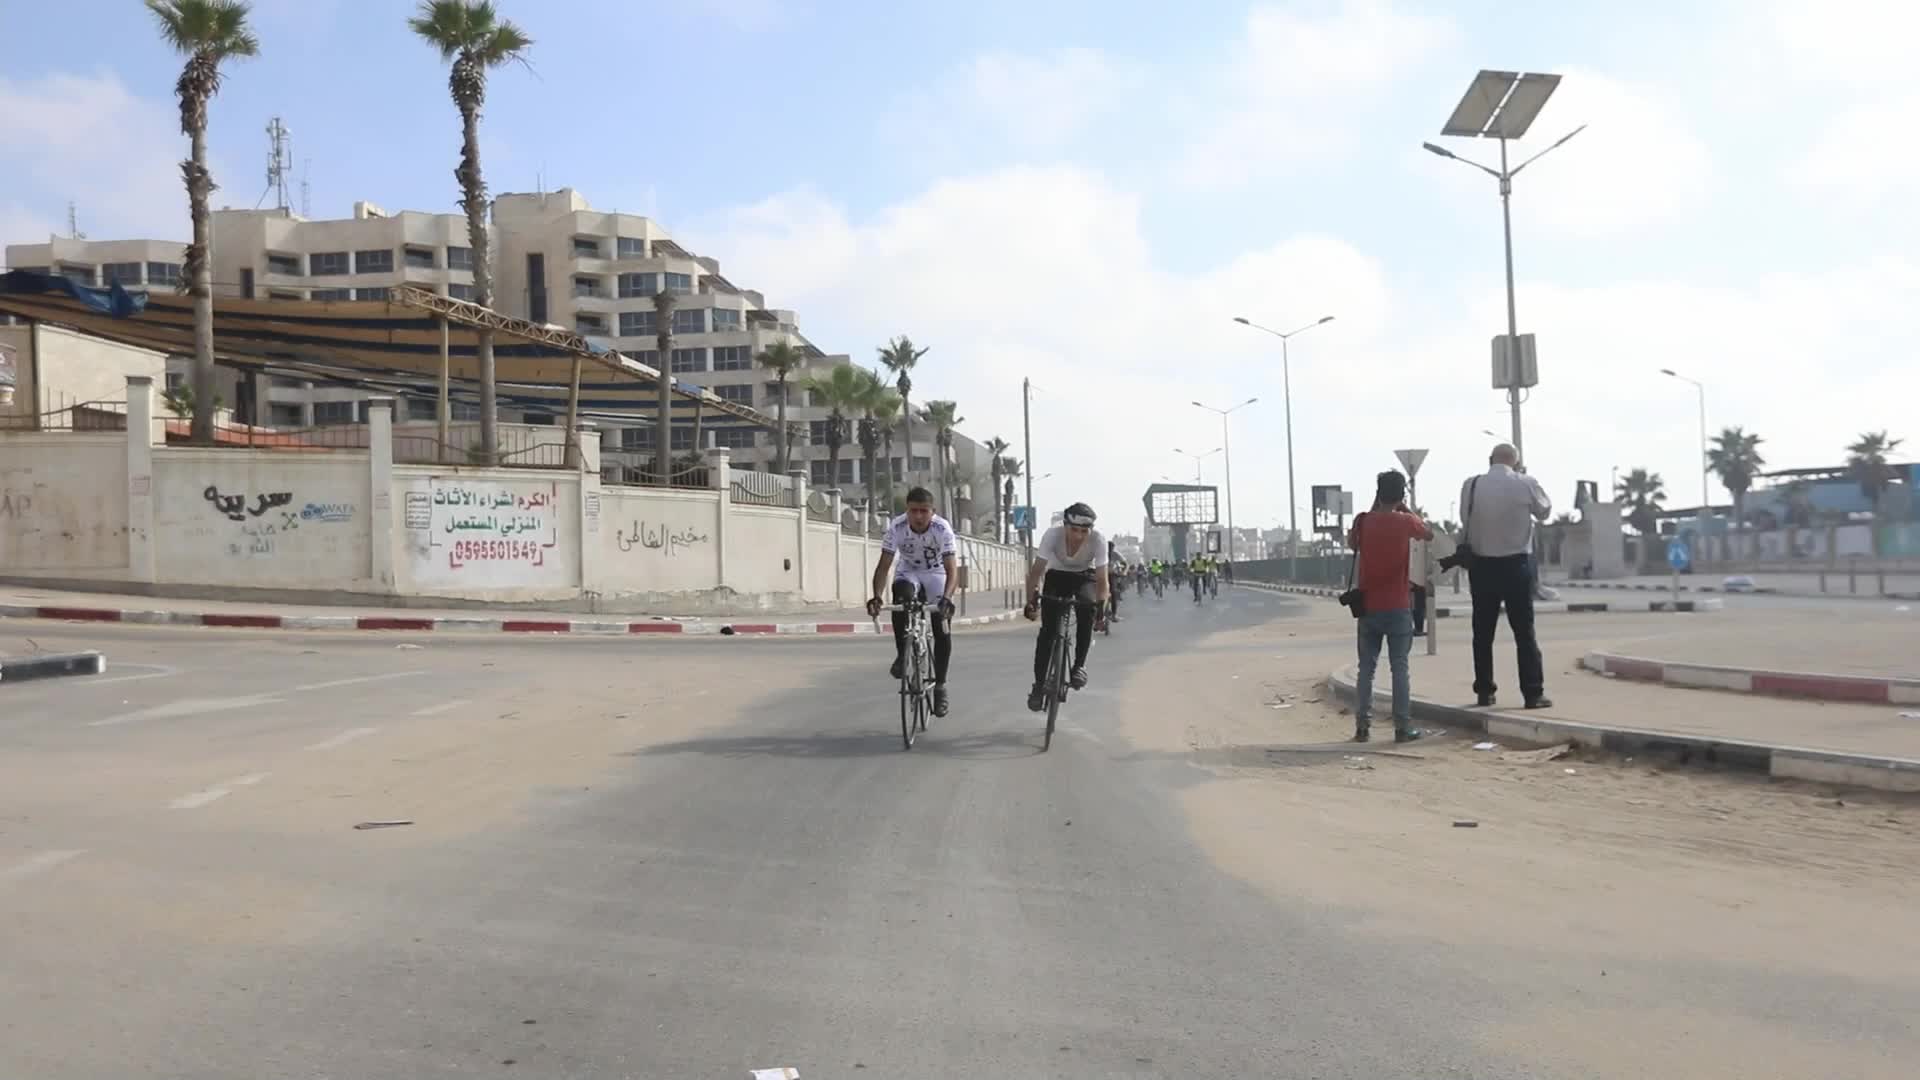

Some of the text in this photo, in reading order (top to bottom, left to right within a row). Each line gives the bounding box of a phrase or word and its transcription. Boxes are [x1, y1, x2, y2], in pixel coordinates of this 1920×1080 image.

[479, 490, 515, 509] لشراء
[518, 492, 549, 511] الكرم
[445, 515, 541, 537] المنزلي المستعمل
[454, 540, 537, 560] 0595501549
